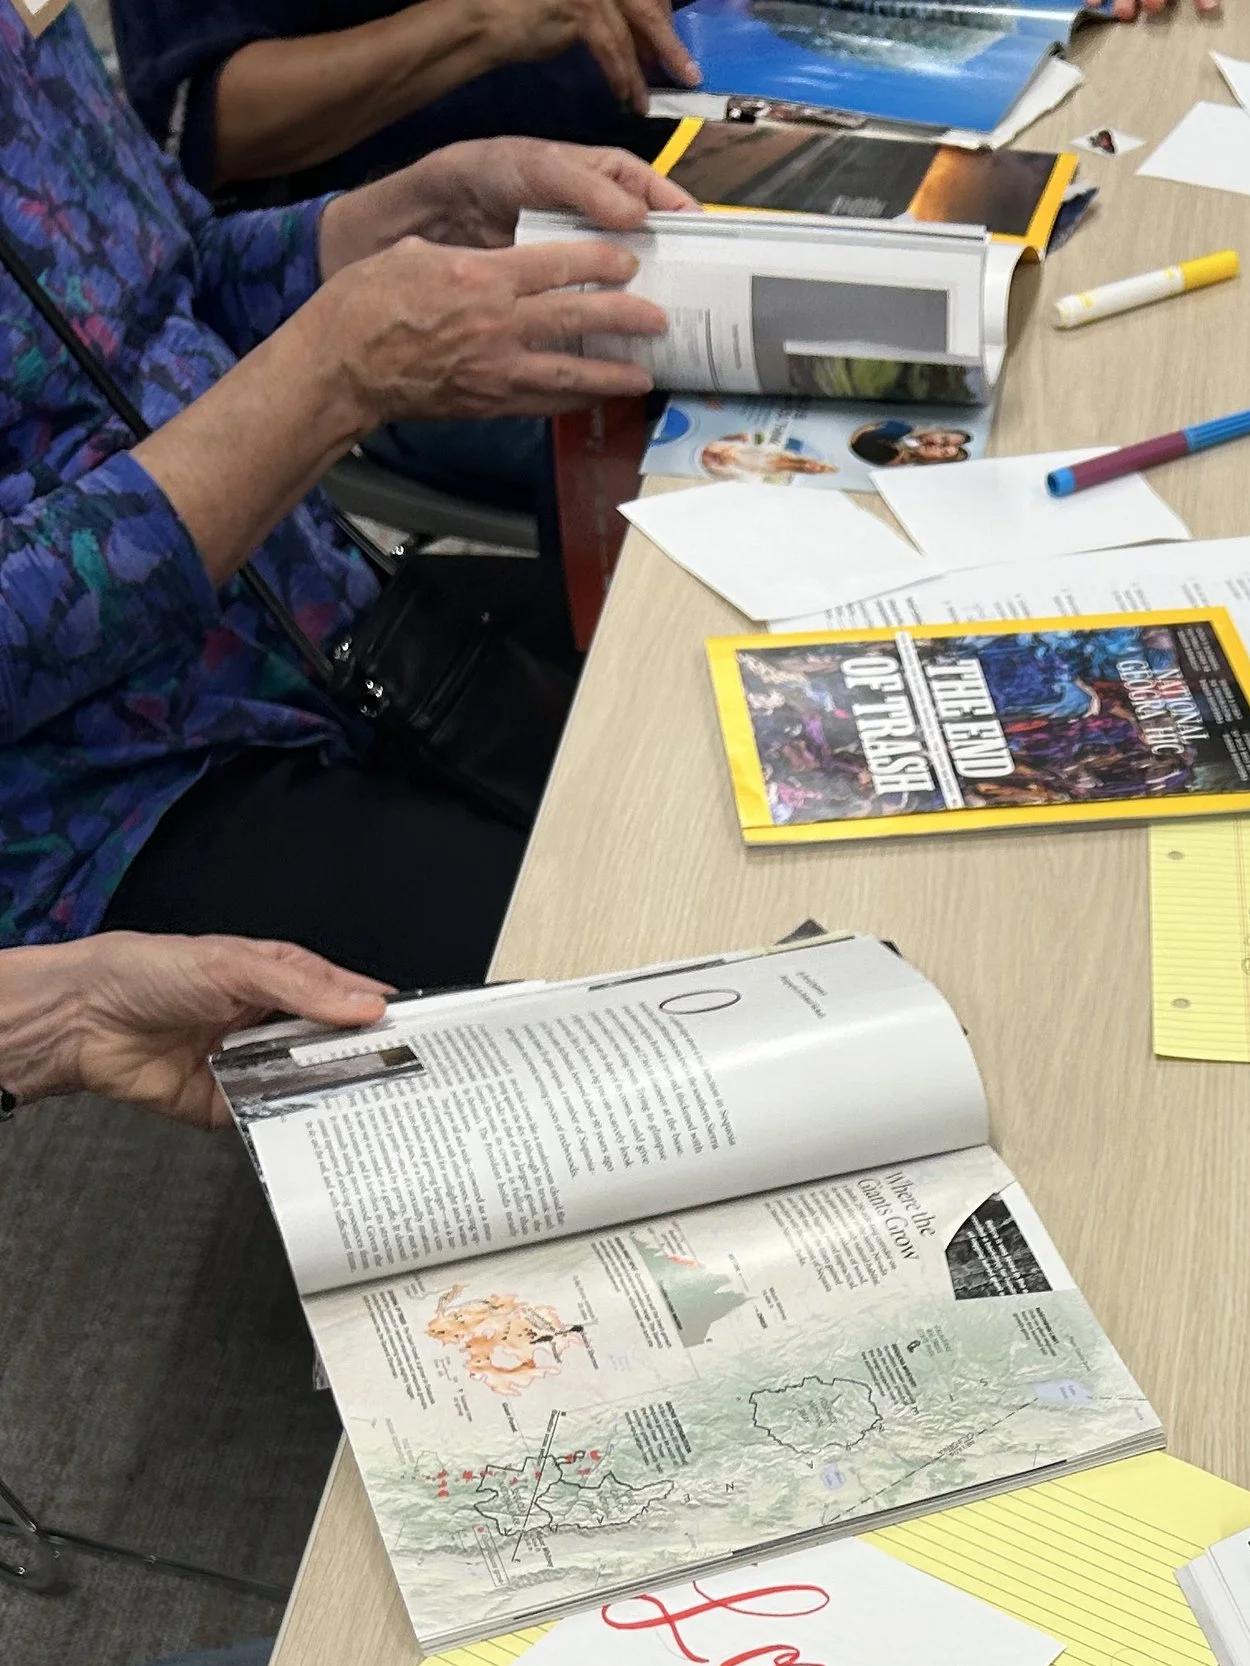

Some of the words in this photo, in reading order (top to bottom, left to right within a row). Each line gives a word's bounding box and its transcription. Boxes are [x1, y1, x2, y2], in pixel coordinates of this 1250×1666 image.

[840, 656, 899, 692] OF
[926, 658, 991, 717] THE
[1116, 660, 1185, 756] GEOGRAHIC
[1164, 667, 1209, 745] NATIONAL
[851, 691, 936, 795] TRASH
[944, 718, 1017, 780] END
[856, 1176, 892, 1216] Giants
[885, 1216, 919, 1259] Grow
[884, 1170, 921, 1211] Where
[911, 1212, 936, 1236] the
